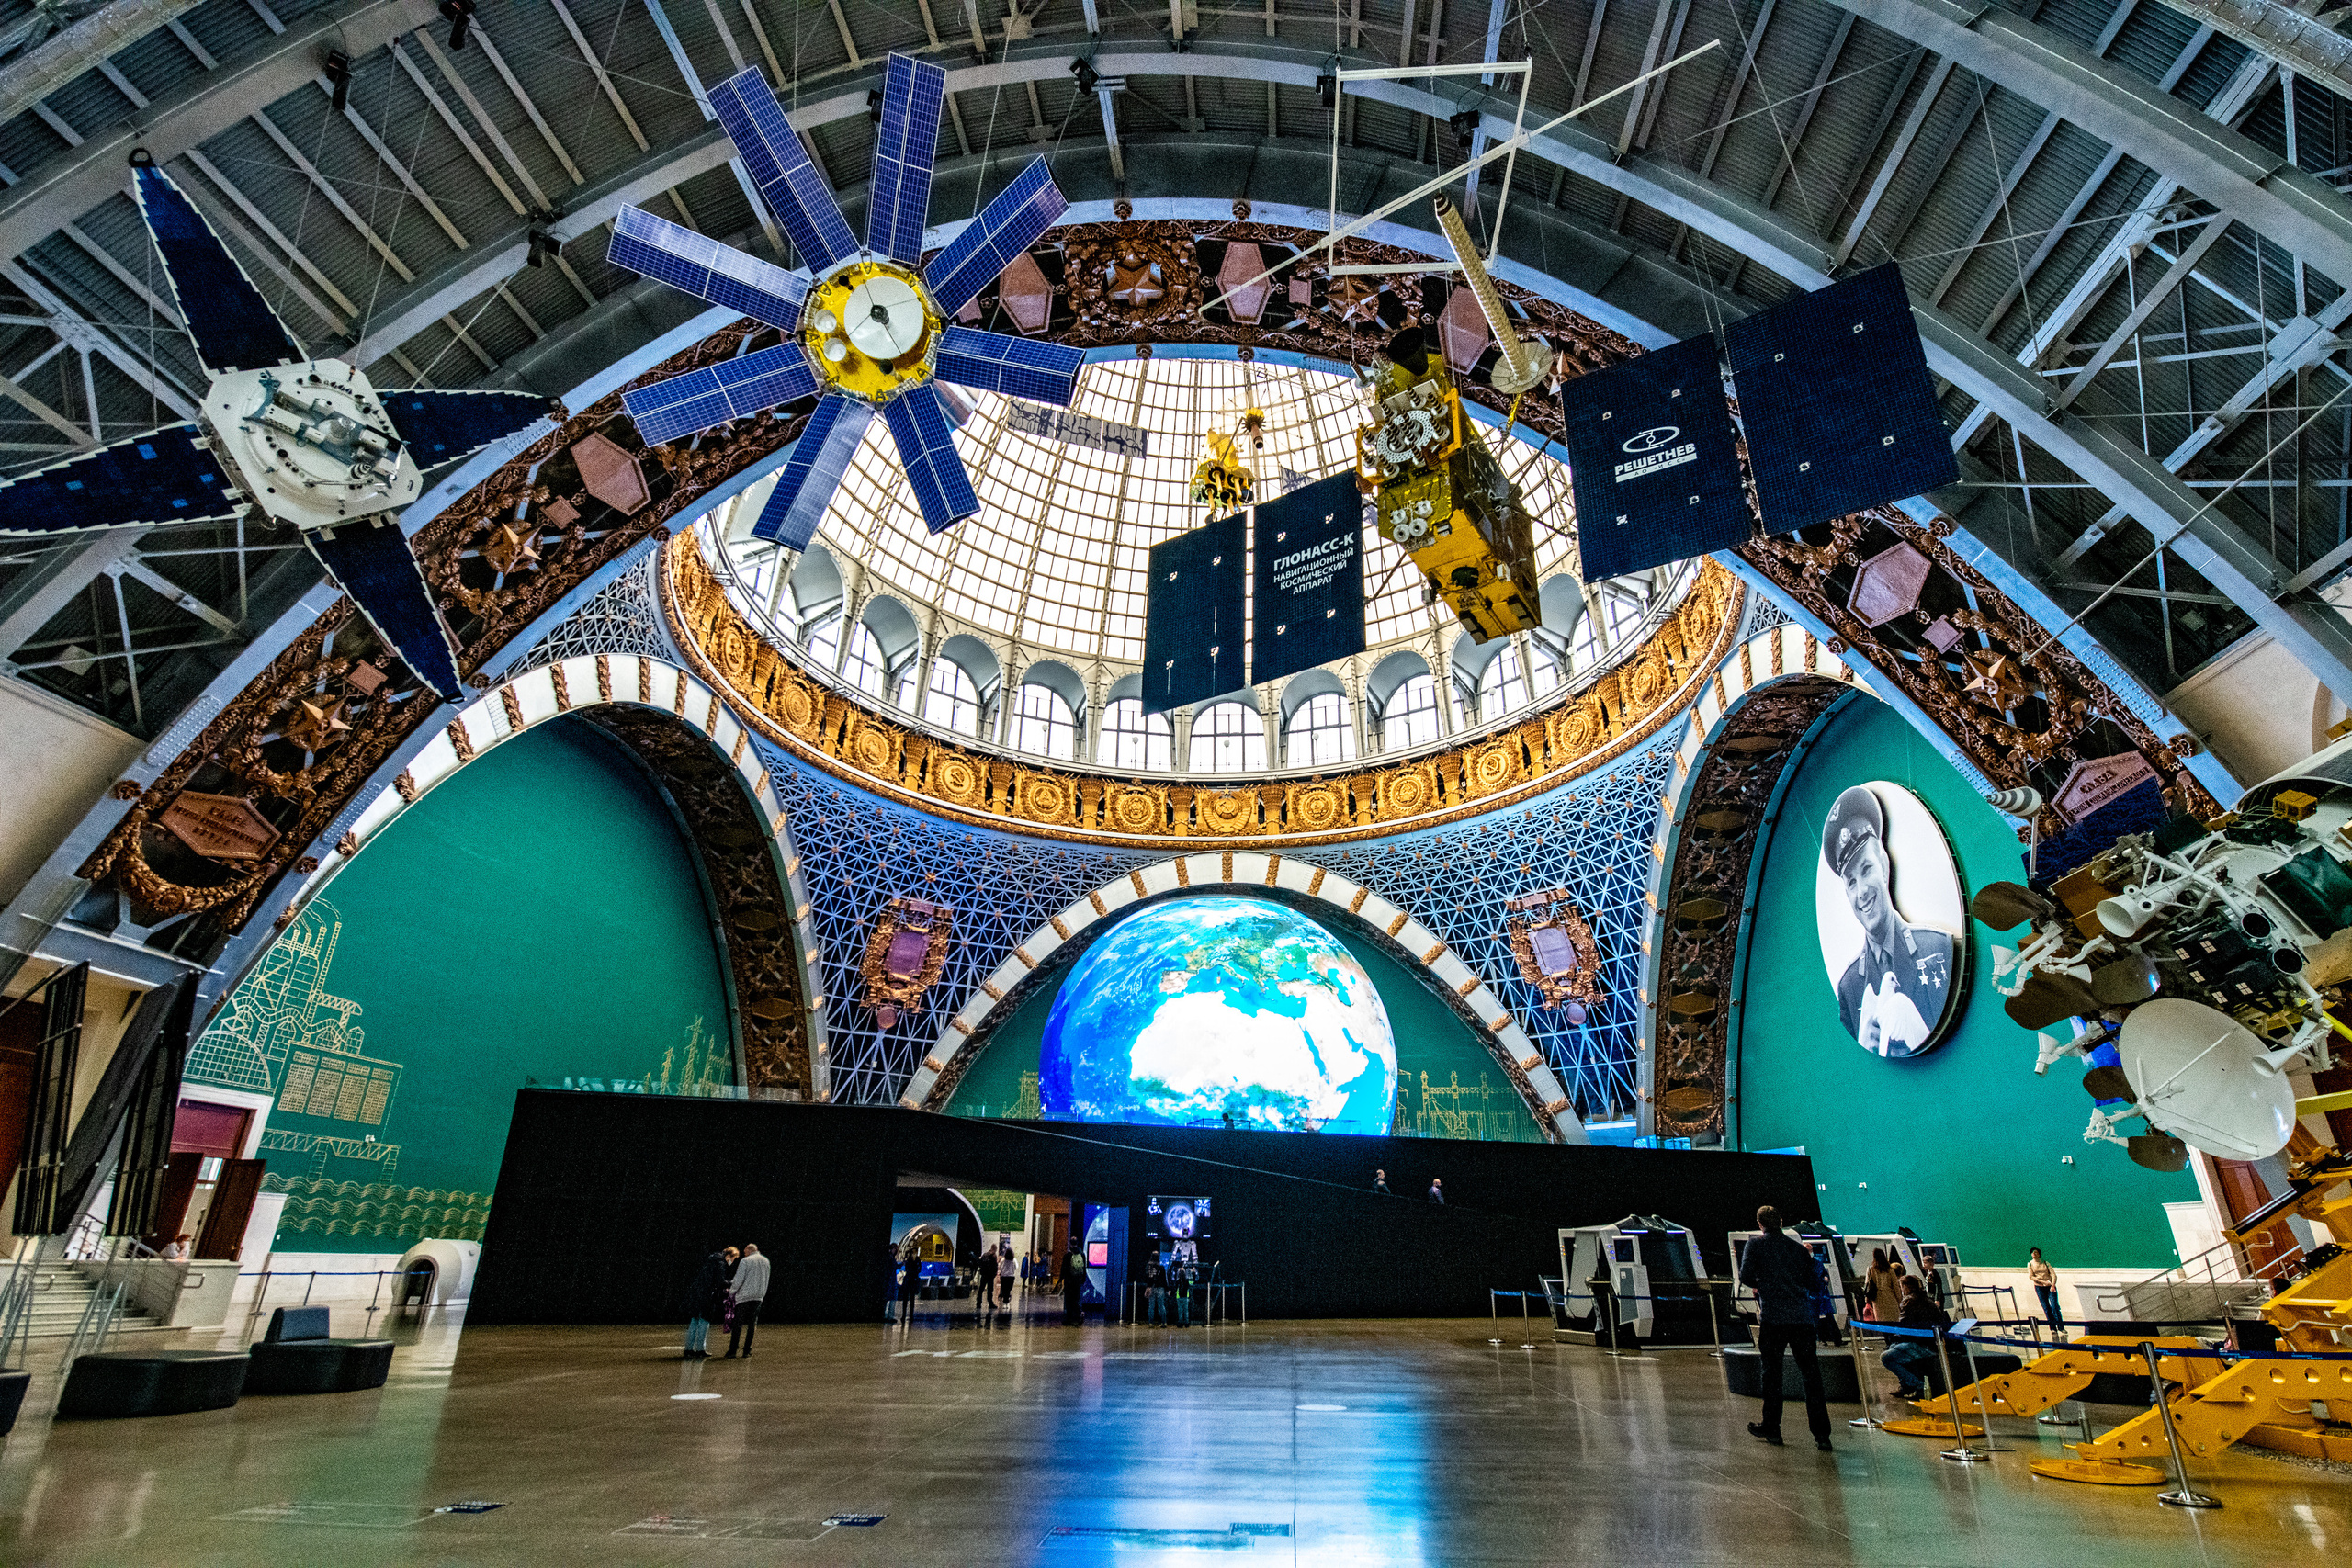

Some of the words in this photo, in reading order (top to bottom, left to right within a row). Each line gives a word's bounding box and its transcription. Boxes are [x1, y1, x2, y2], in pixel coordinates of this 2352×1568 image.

[1614, 443, 1696, 475] РЕШЕТНЕВ
[1273, 532, 1354, 571] ГЛОНАСС-К
[1273, 547, 1354, 583] НАВИГАЦИОННЫЙ
[1280, 559, 1347, 590] КОСМИЧЕСКИЙ
[1293, 574, 1334, 595] АППАРАТ
[2079, 770, 2115, 794] СЛАВА
